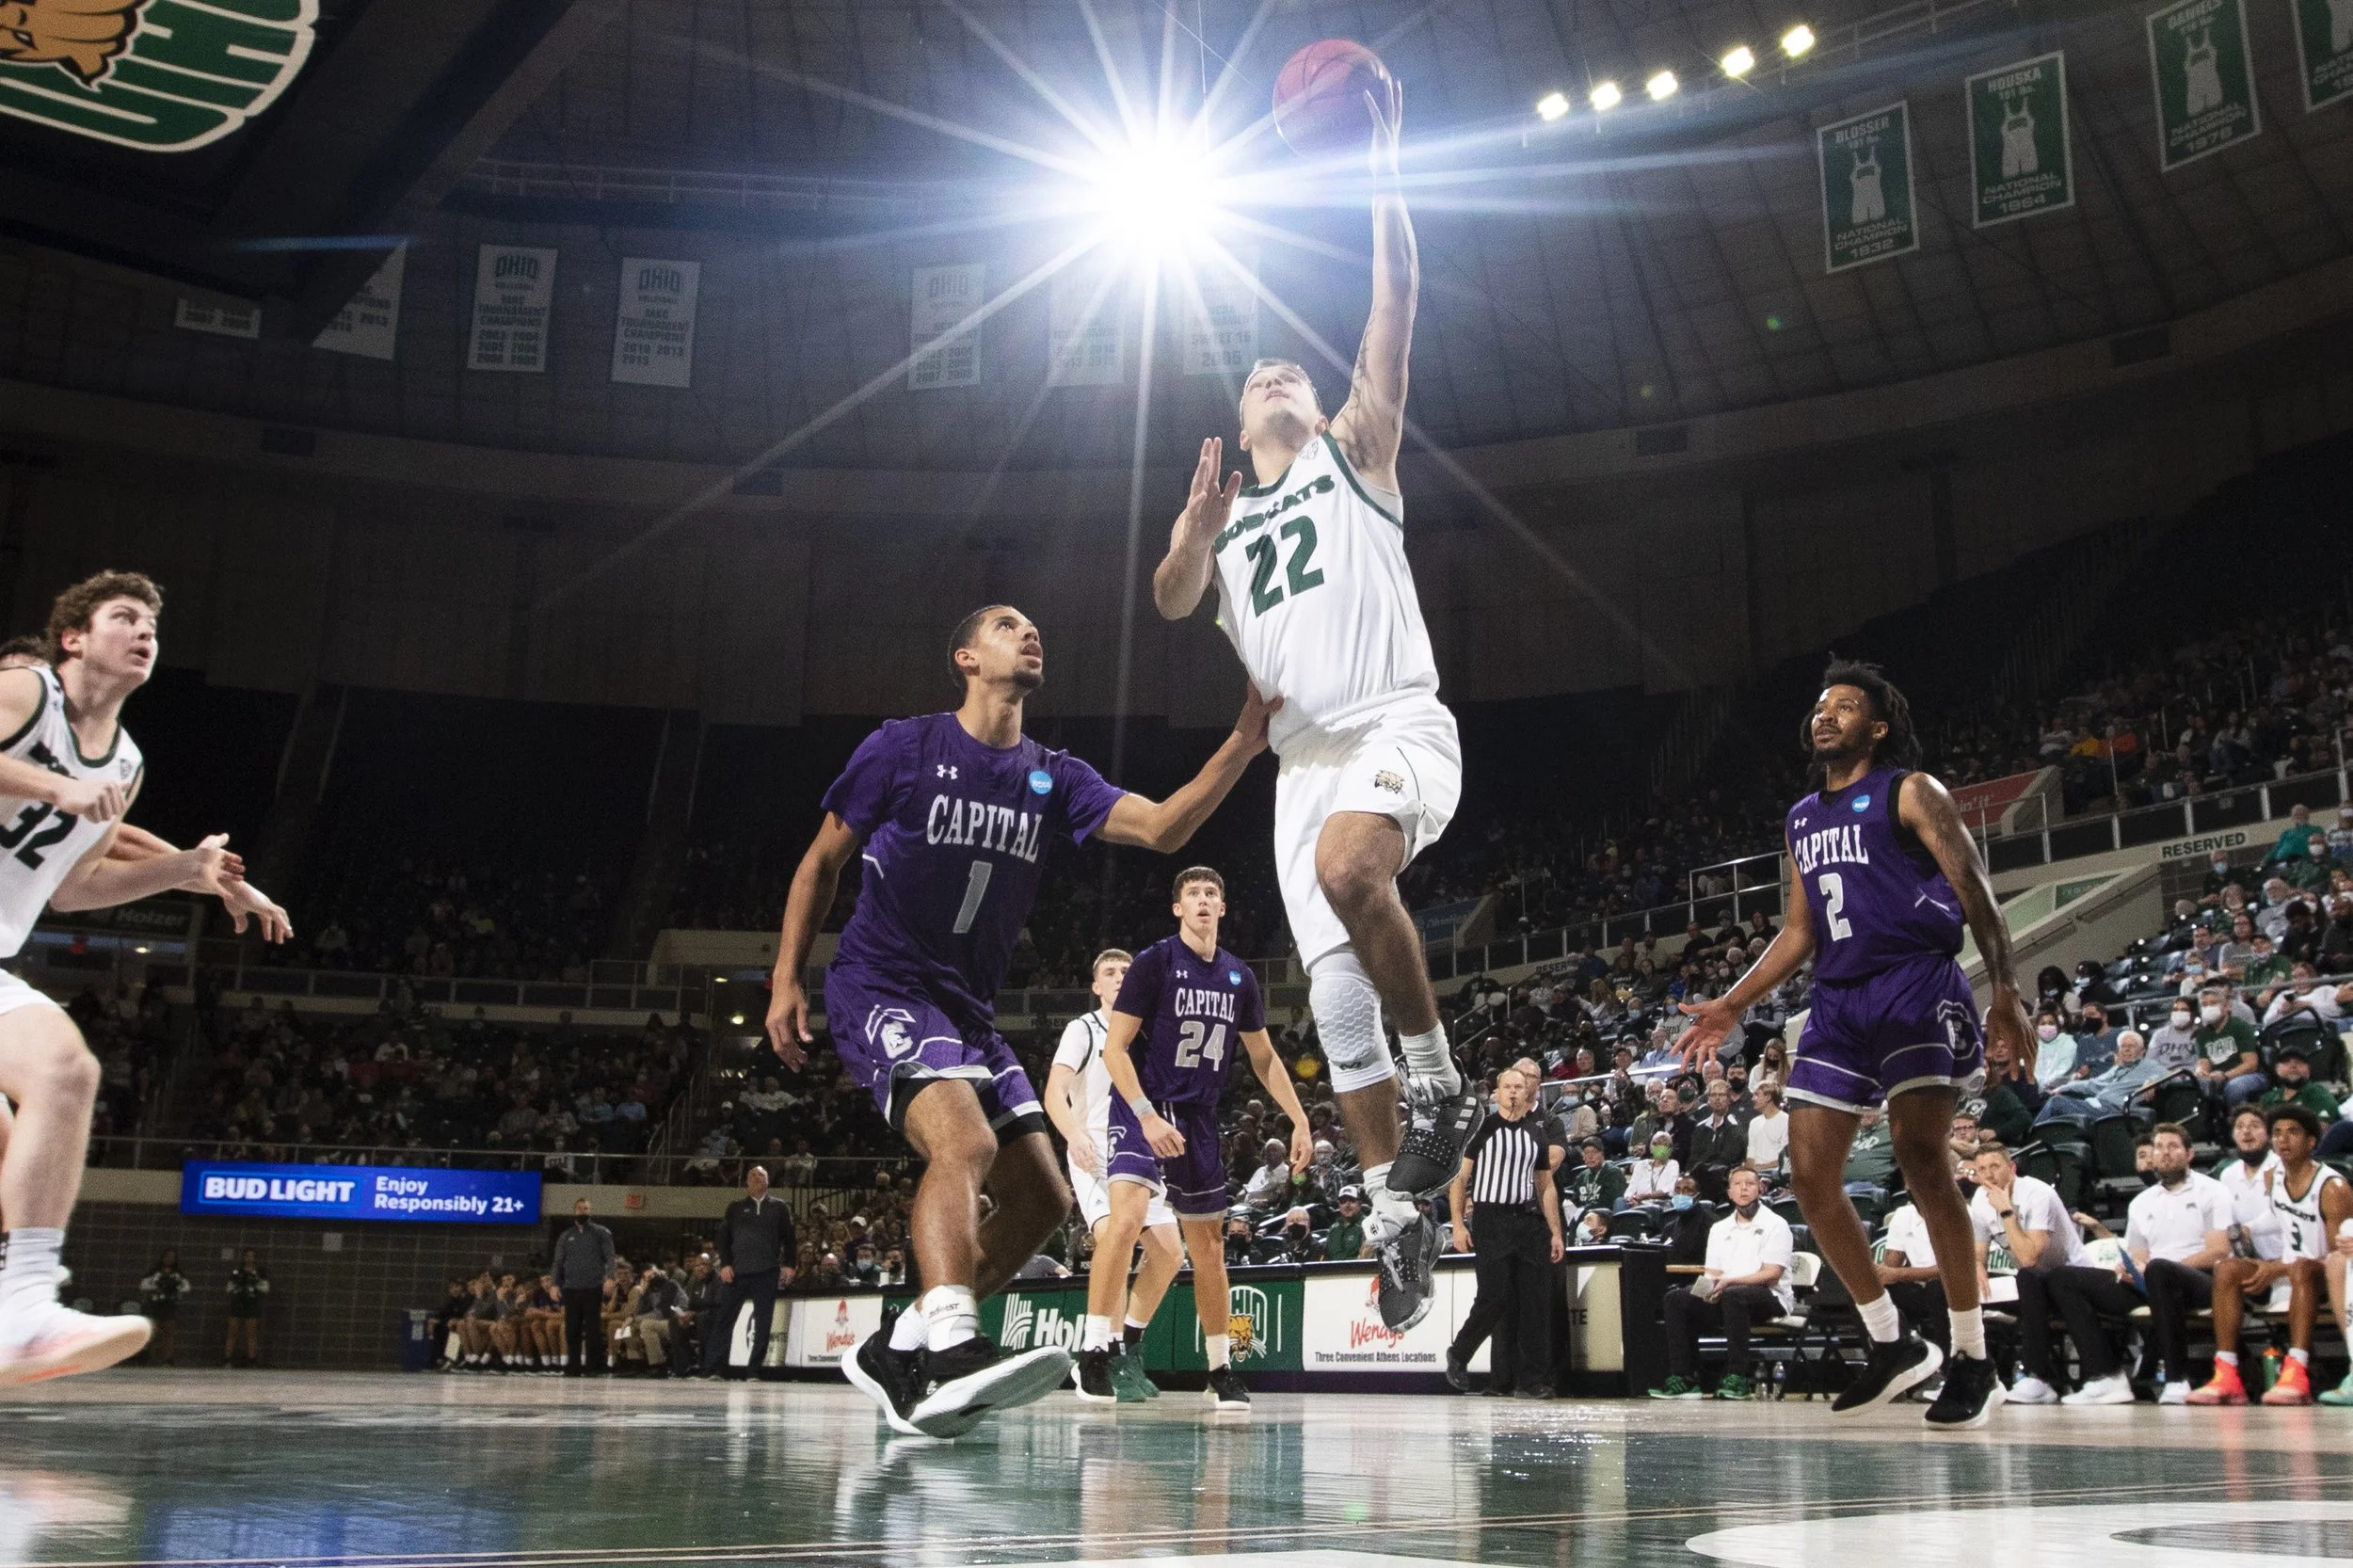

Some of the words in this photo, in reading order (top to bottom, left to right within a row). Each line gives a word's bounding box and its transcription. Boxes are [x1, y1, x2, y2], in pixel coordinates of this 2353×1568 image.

[1987, 66, 2041, 93] HOUSKA
[1834, 116, 1890, 144] BLOSSER
[1981, 179, 2062, 204] CHAMPION
[1984, 172, 2058, 195] NATIONAL
[1834, 224, 1908, 251] CHAMPION
[1836, 216, 1903, 240] NATIONAL
[495, 255, 538, 280] OHIO
[639, 268, 681, 294] OHIO
[1244, 515, 1325, 619] 22
[927, 794, 1043, 863] CAPITAL
[1795, 824, 1869, 875] CAPITAL
[2162, 831, 2247, 859] RESERVED
[952, 860, 993, 934] 1
[1818, 872, 1853, 942] 2
[1175, 987, 1236, 1023] CAPITAL
[1174, 1020, 1227, 1072] 24
[205, 1176, 268, 1200] BUD
[270, 1179, 355, 1202] LIGHT
[376, 1176, 428, 1195] Enjoy
[375, 1194, 488, 1215] Responsibly
[491, 1196, 524, 1212] 21+
[1033, 1308, 1088, 1352] Hol
[1315, 1352, 1335, 1363] Three
[1335, 1352, 1375, 1363] Convenient
[1376, 1352, 1401, 1363] Athens
[1401, 1352, 1436, 1363] Locations
